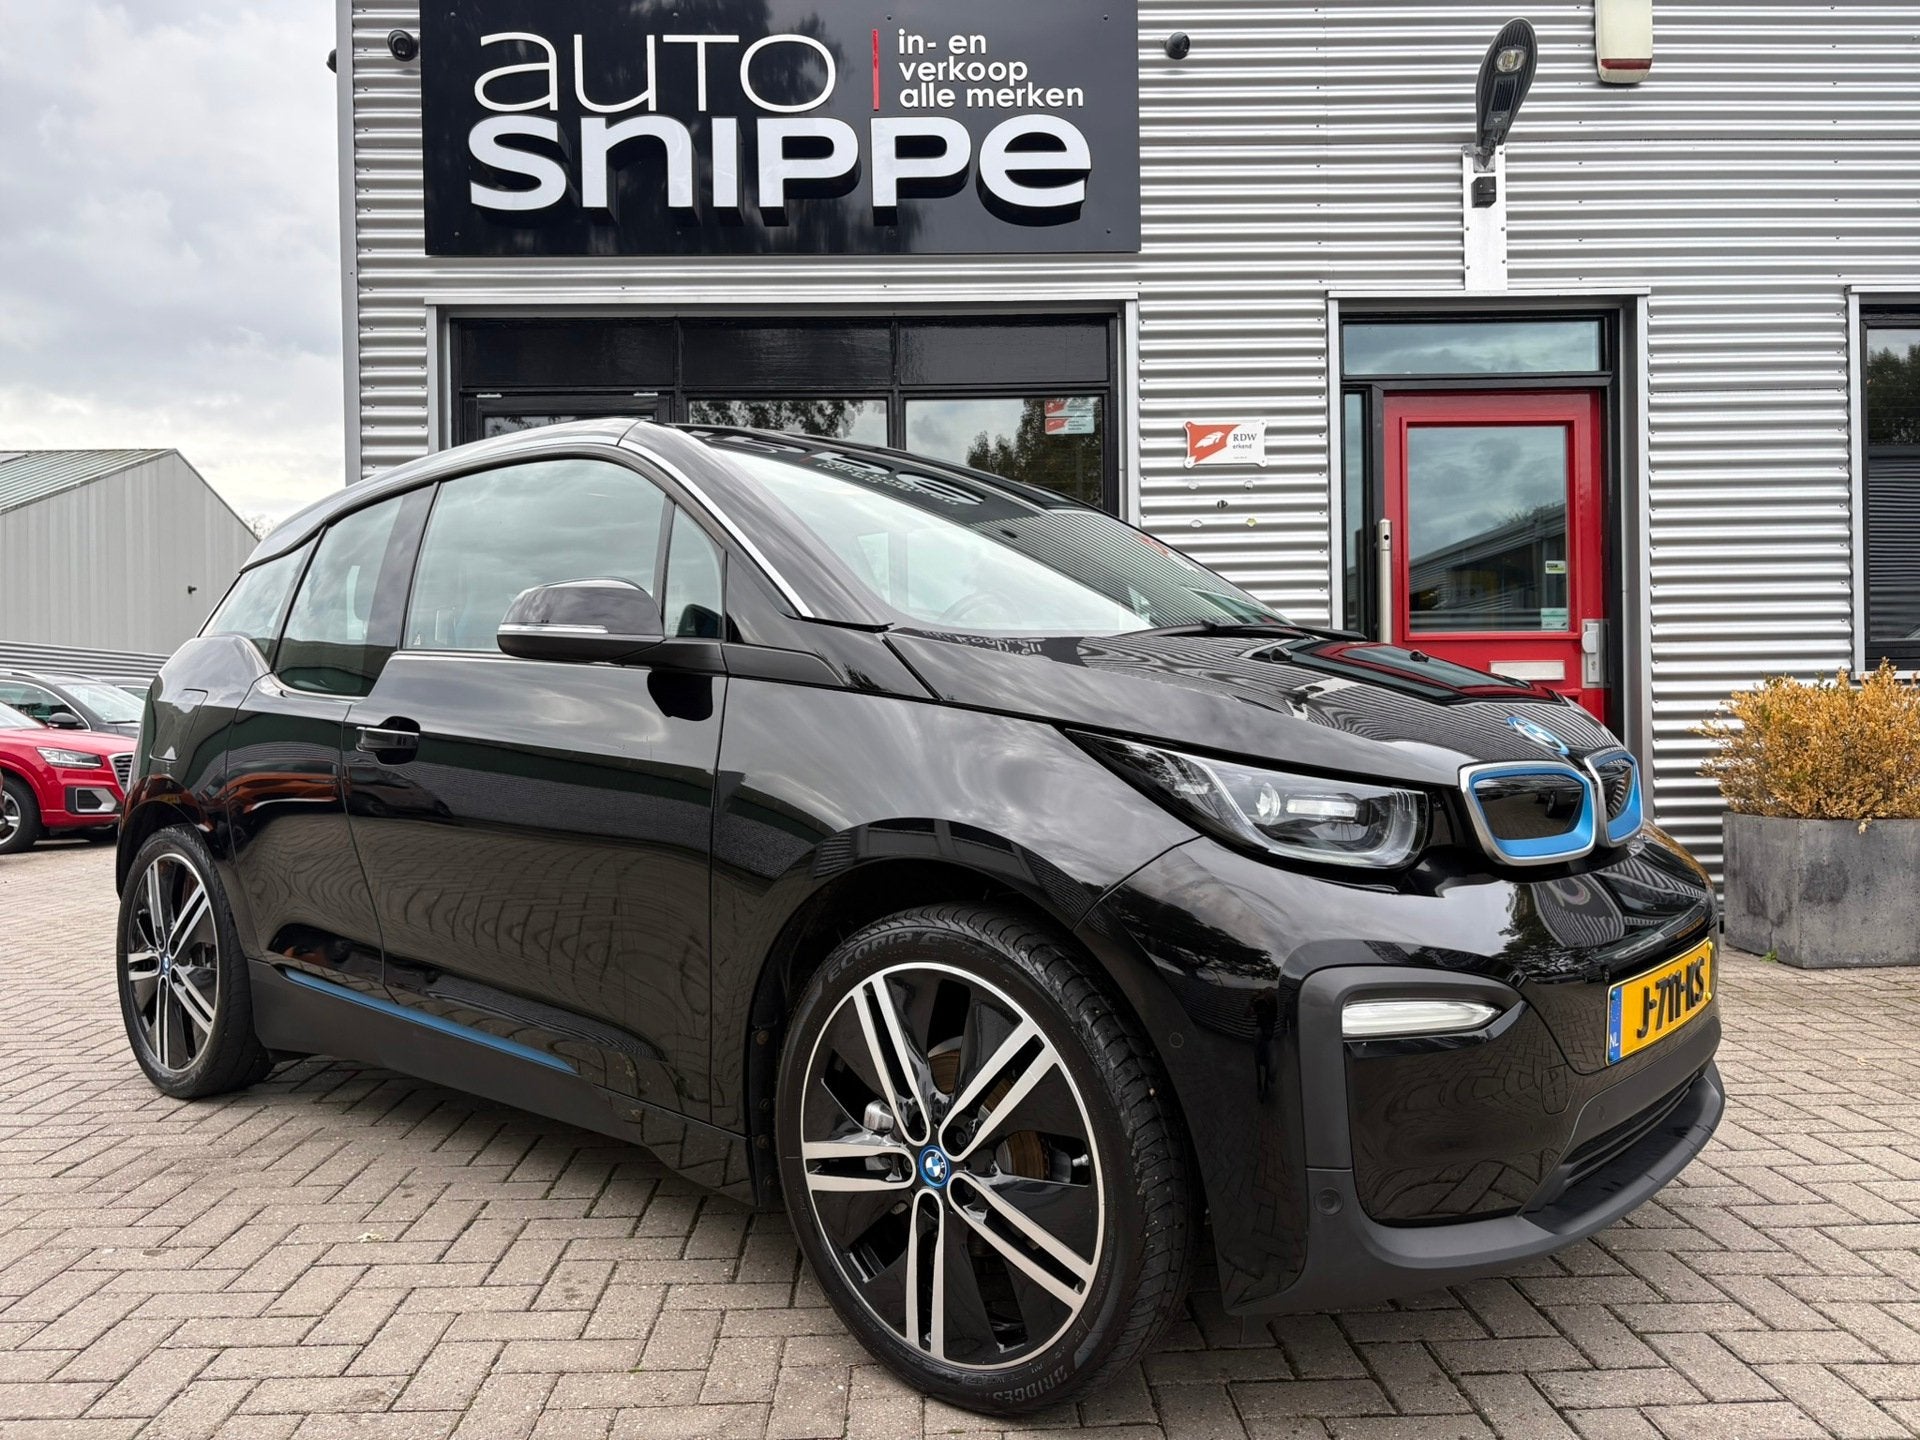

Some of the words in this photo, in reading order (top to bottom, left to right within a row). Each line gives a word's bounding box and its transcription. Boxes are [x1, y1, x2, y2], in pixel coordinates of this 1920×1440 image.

[899, 28, 937, 54] in-
[949, 34, 987, 54] en
[899, 56, 1029, 86] verkoop
[900, 82, 956, 108] alle
[966, 82, 1085, 108] merken
[1232, 433, 1258, 442] RDW
[1609, 1032, 1619, 1049] NL
